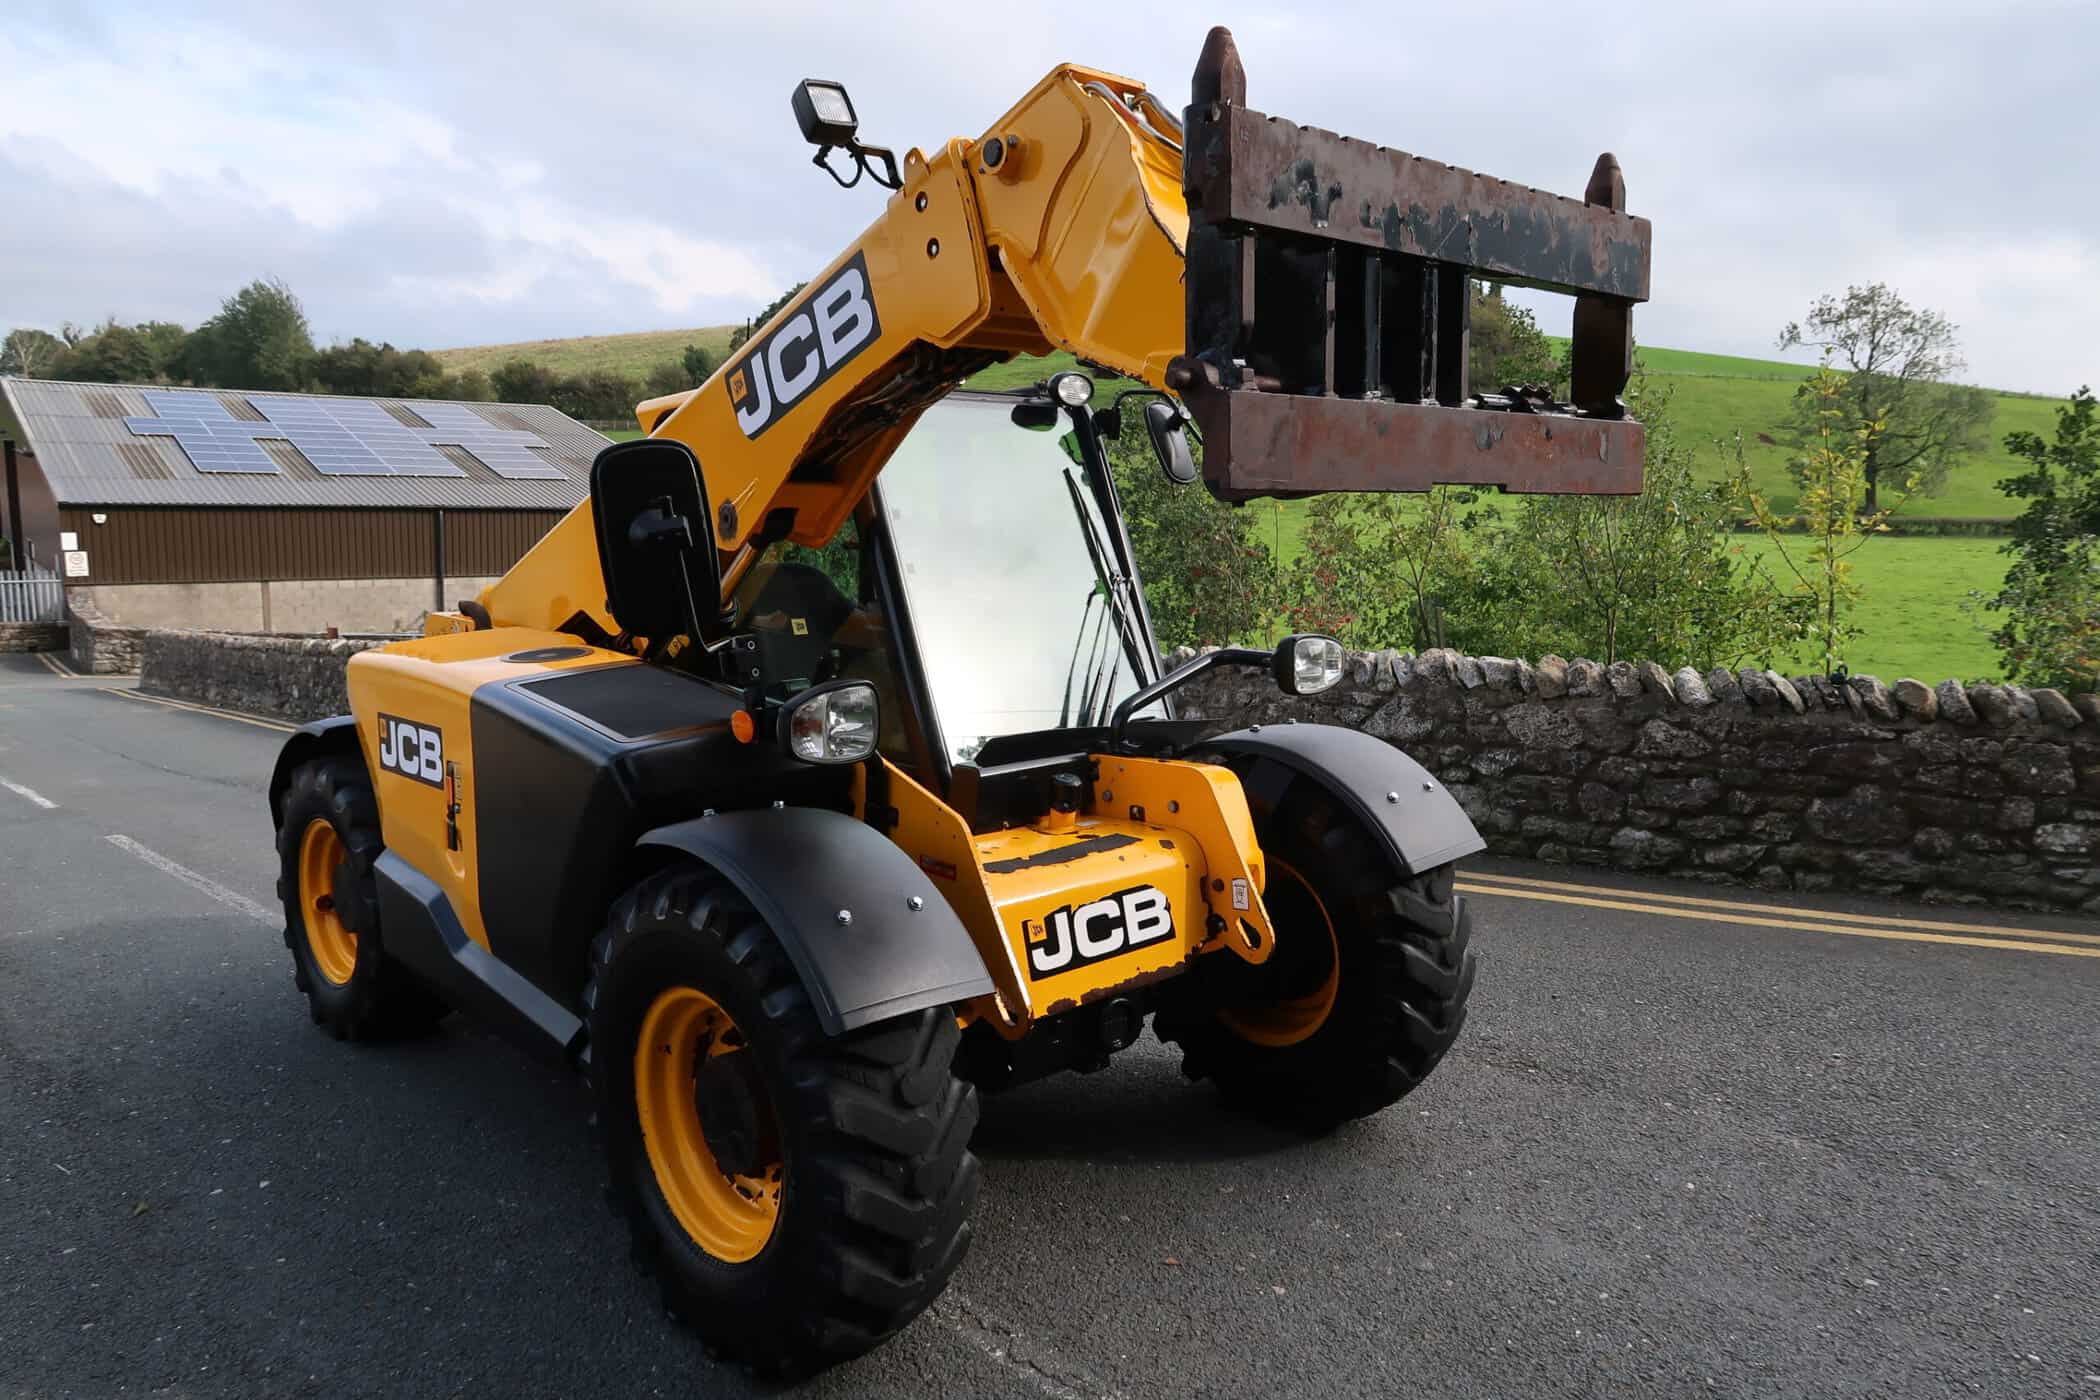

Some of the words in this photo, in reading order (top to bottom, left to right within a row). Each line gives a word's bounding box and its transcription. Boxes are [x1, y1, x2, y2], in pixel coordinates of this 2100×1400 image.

[737, 268, 873, 436] JCB
[381, 720, 442, 782] JCB
[1032, 888, 1171, 971] JCB
